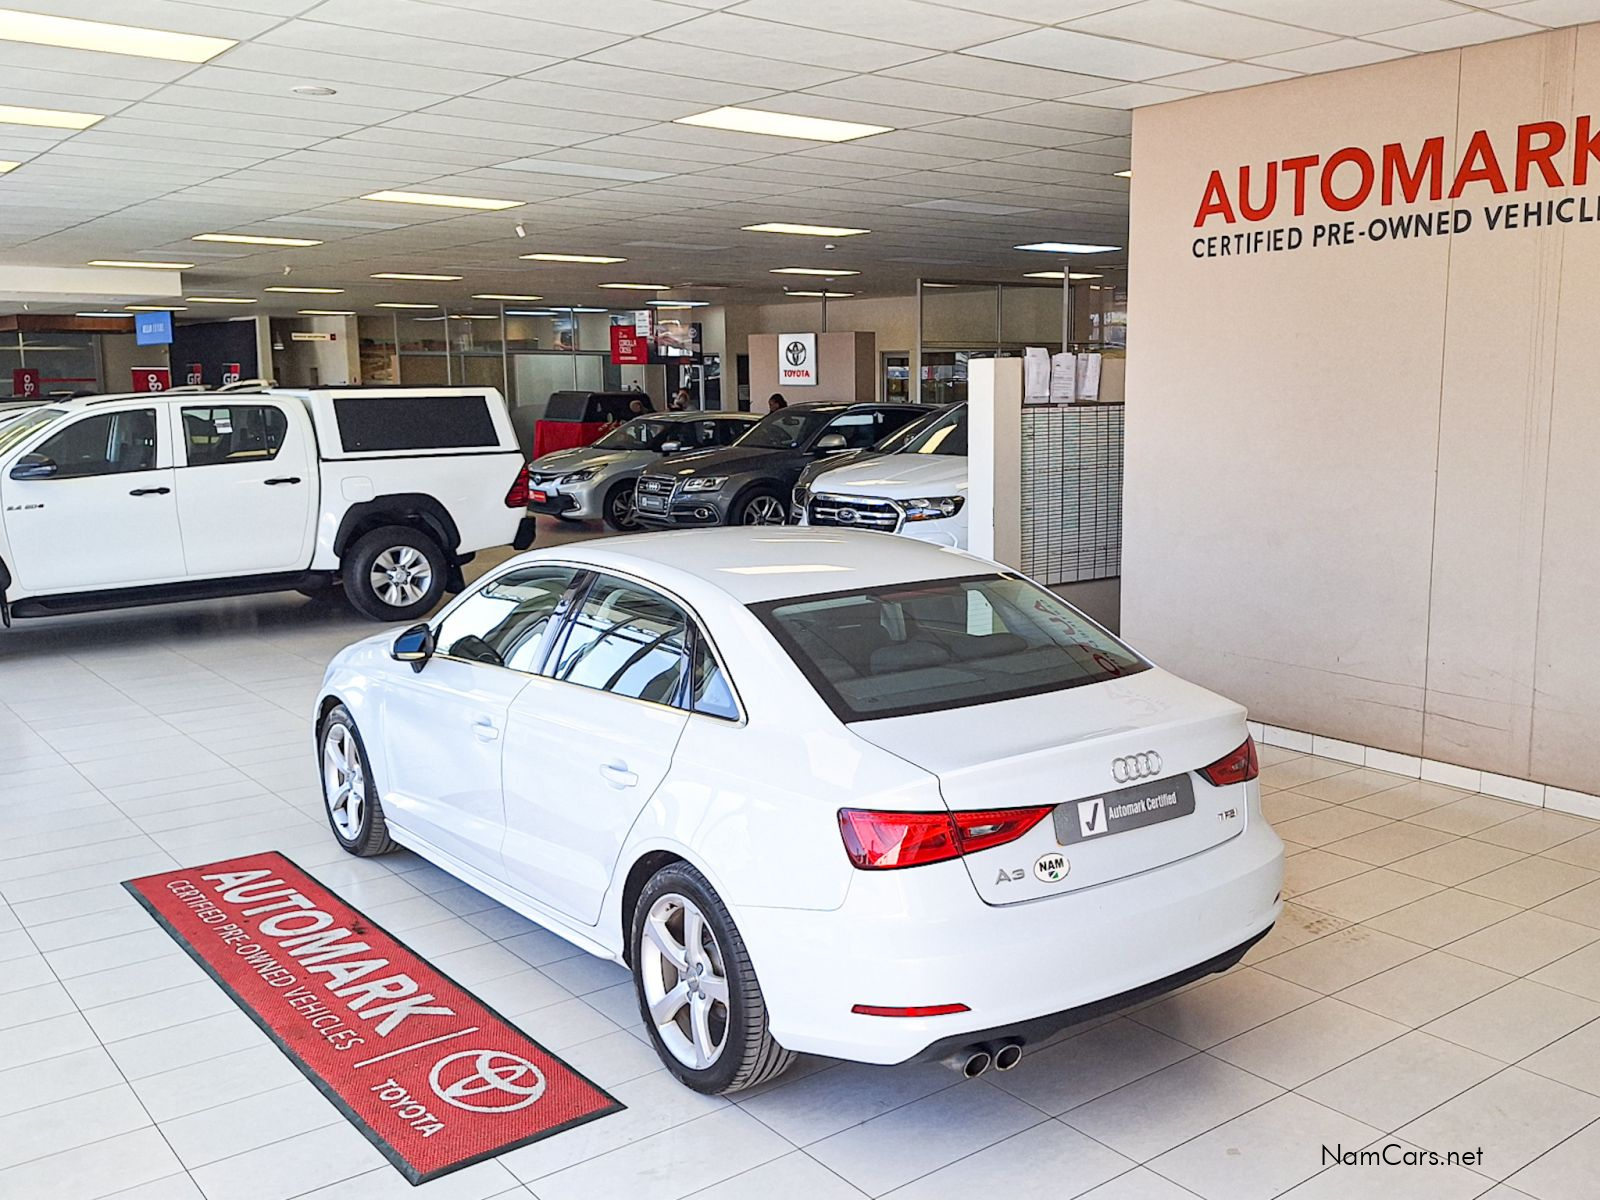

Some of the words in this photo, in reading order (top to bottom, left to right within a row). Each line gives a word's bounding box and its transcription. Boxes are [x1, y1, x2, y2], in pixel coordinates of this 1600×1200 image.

[1193, 115, 1600, 228] AUTOMARK
[1192, 227, 1302, 258] CERTIFIED
[1313, 208, 1473, 248] PRE-OWNED
[1484, 195, 1600, 231] VEHICL
[783, 369, 811, 378] TOYOTA
[1108, 801, 1147, 820] Automark
[1147, 791, 1177, 811] Certified
[995, 868, 1026, 886] A3
[1038, 858, 1065, 873] NAM
[166, 879, 227, 925] CERTIFIED
[221, 922, 298, 989] PRE-OWNED
[281, 986, 367, 1052] VEHICLES
[201, 868, 457, 1039] AUTOMARK
[370, 1078, 446, 1139] TOYOTA
